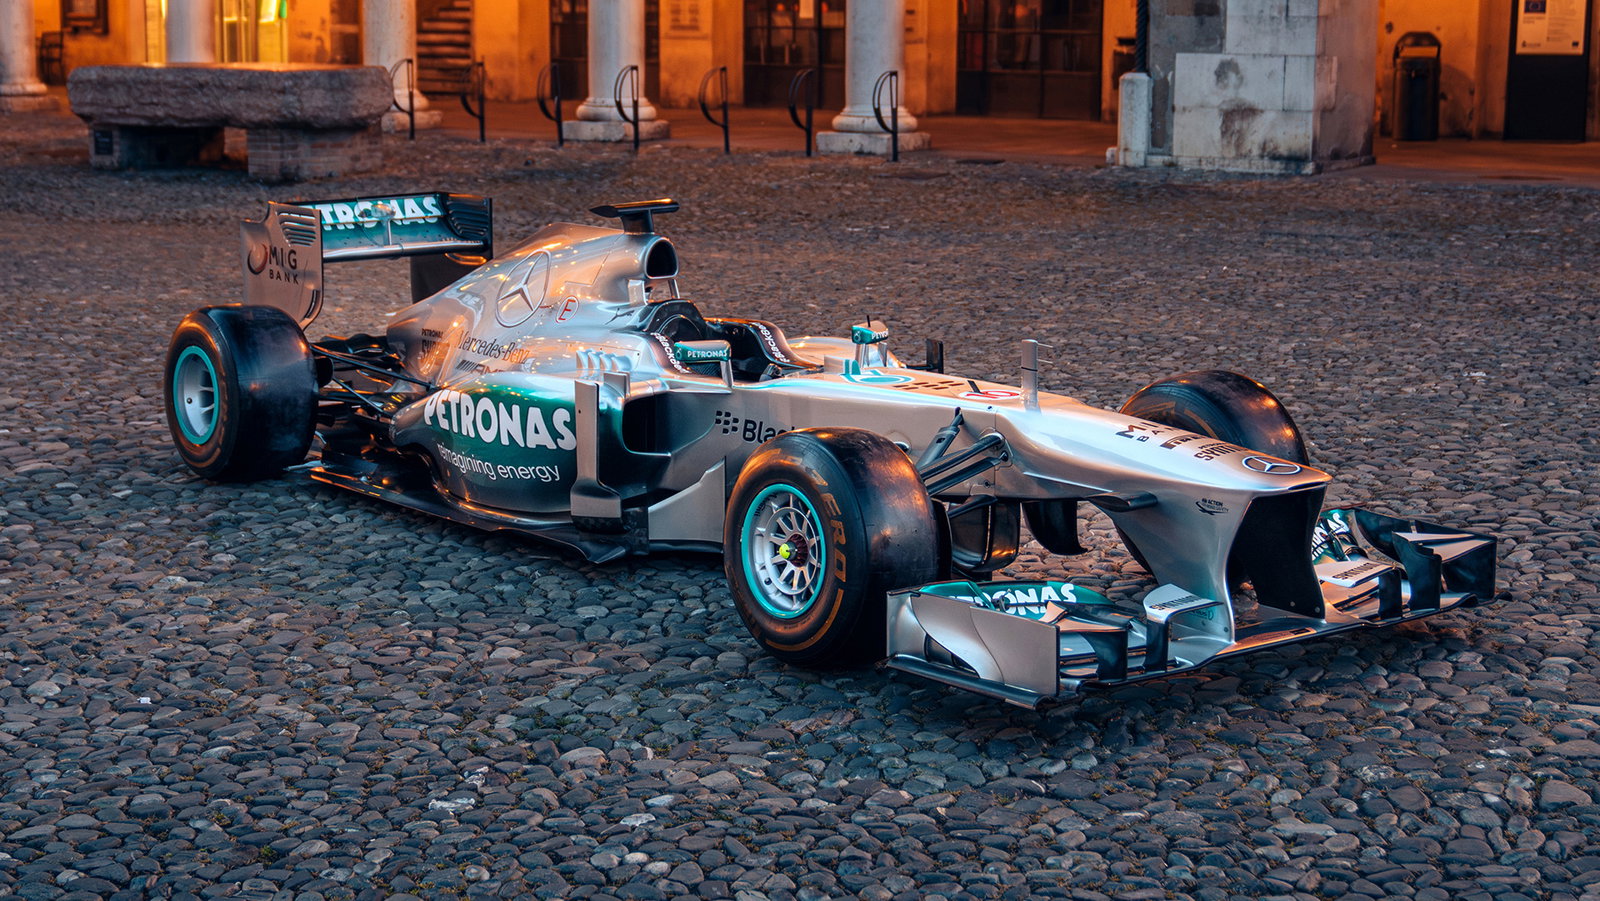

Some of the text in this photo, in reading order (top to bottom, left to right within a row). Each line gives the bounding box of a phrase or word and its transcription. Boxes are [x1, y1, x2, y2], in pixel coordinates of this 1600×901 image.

[269, 246, 298, 270] MIG
[269, 269, 299, 285] BANK
[557, 298, 577, 322] E
[458, 330, 531, 365] Mercedes-Benz
[687, 350, 727, 358] PETRONAS
[424, 389, 577, 450] PETRONAS
[437, 442, 561, 482] reimagining energy
